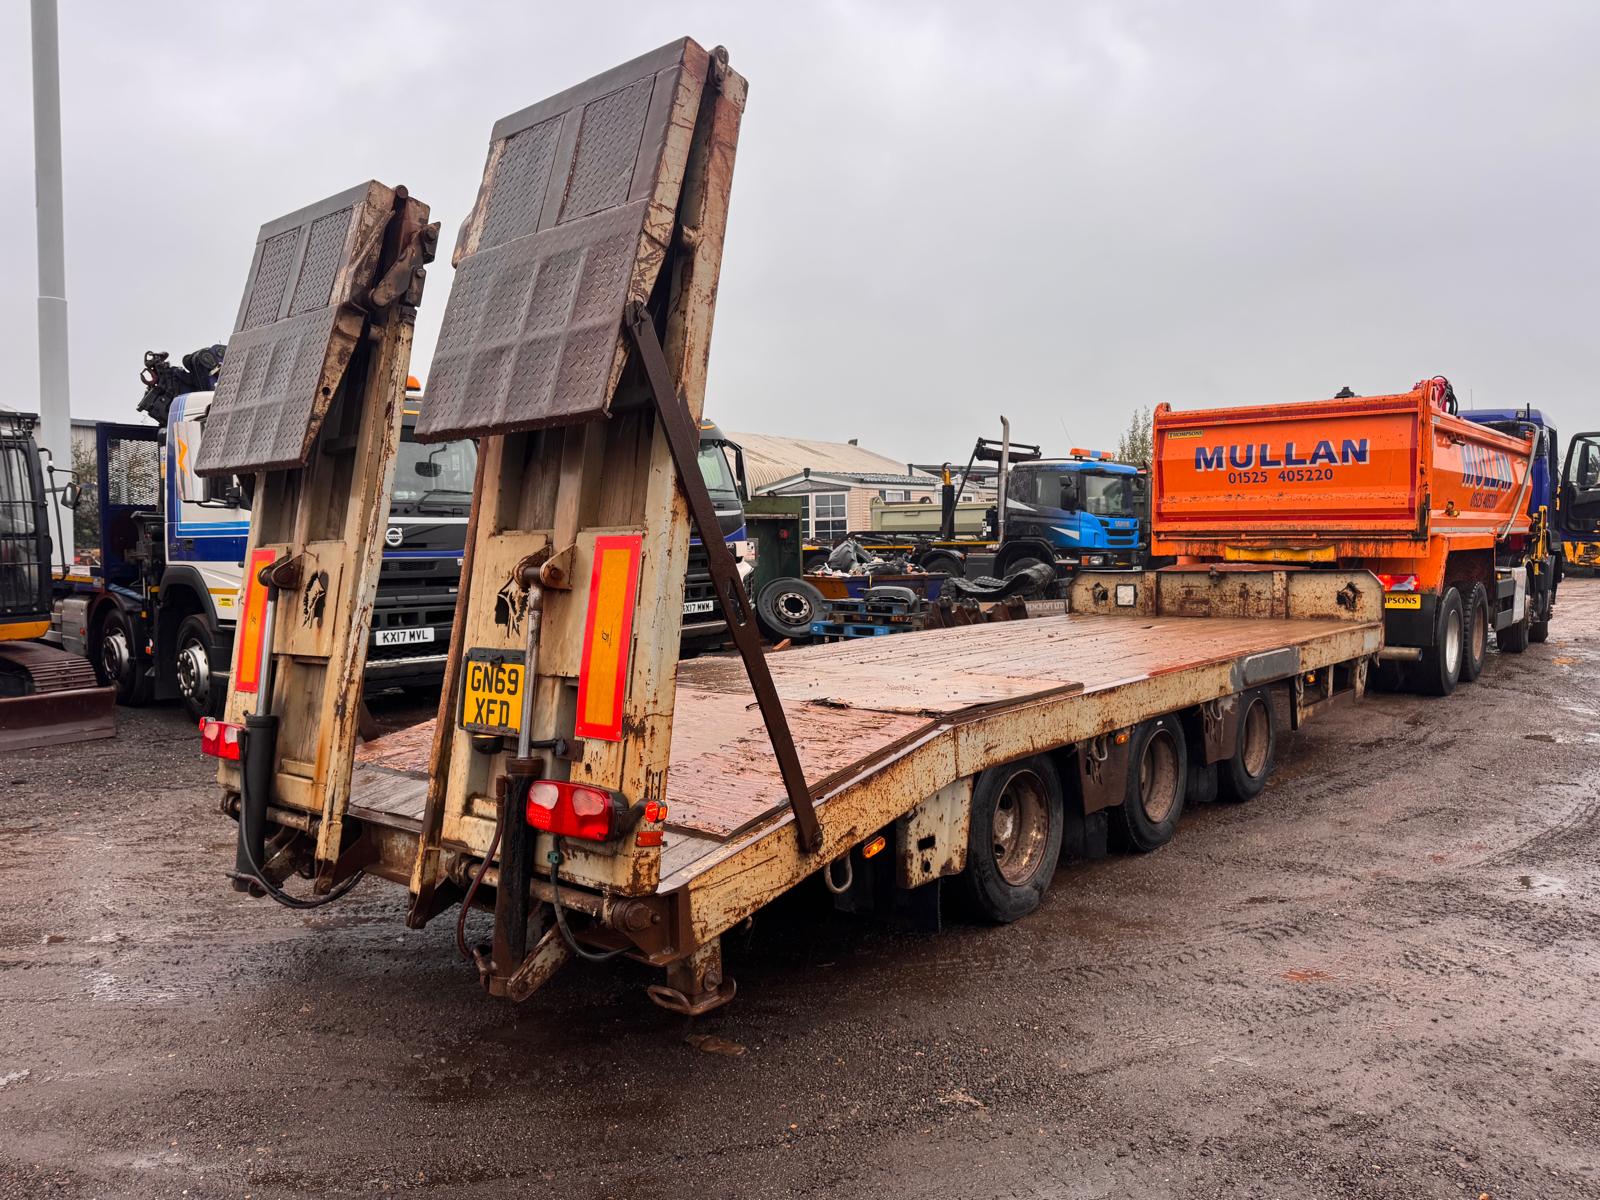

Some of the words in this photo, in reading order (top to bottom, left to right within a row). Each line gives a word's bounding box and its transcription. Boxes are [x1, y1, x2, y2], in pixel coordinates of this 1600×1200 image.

[1195, 438, 1369, 472] MULLAN
[1461, 443, 1513, 493] MULLAN
[1228, 471, 1268, 484] 01525
[1278, 468, 1333, 482] 405220
[383, 631, 407, 643] KX17
[409, 630, 429, 642] MVL
[471, 666, 519, 696] GN69
[473, 697, 510, 728] XFD
